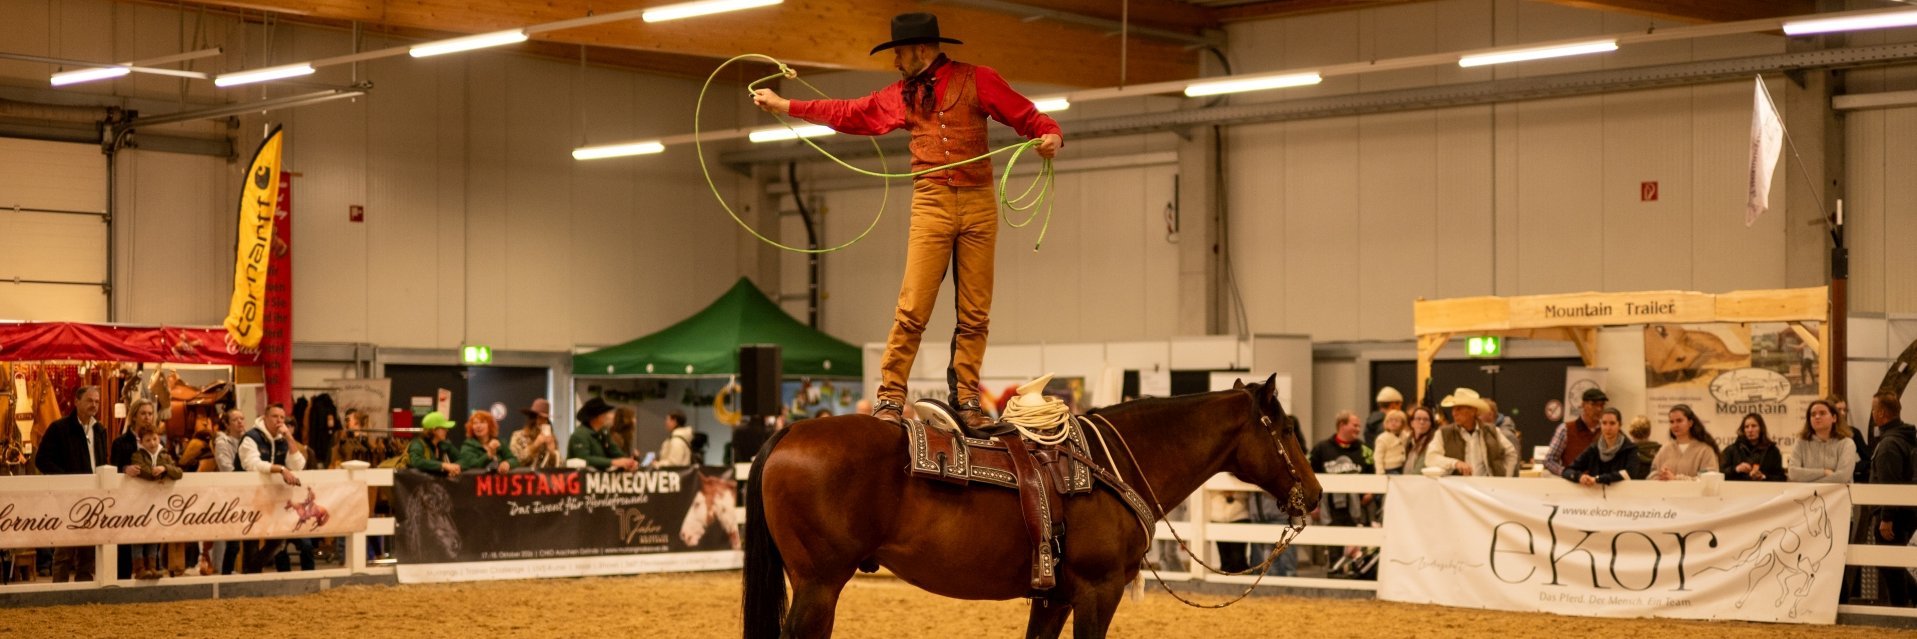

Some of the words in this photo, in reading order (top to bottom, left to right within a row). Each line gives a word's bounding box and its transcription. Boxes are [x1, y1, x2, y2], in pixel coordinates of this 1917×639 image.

[1545, 302, 1612, 318] Mountain
[1625, 300, 1676, 315] Trailer
[1715, 402, 1787, 415] Mountain
[476, 472, 580, 497] MUSTANG
[586, 470, 680, 494] MAKEOVER
[66, 496, 155, 530] Brand
[156, 493, 262, 535] Saddlery
[507, 500, 530, 516] Das
[564, 495, 584, 516] für
[1562, 506, 1677, 520] www.ekor-magazin.de
[1490, 504, 1717, 592] ekor
[1539, 591, 1556, 602] Das
[1589, 594, 1605, 605] Der
[1665, 597, 1691, 607] Team
